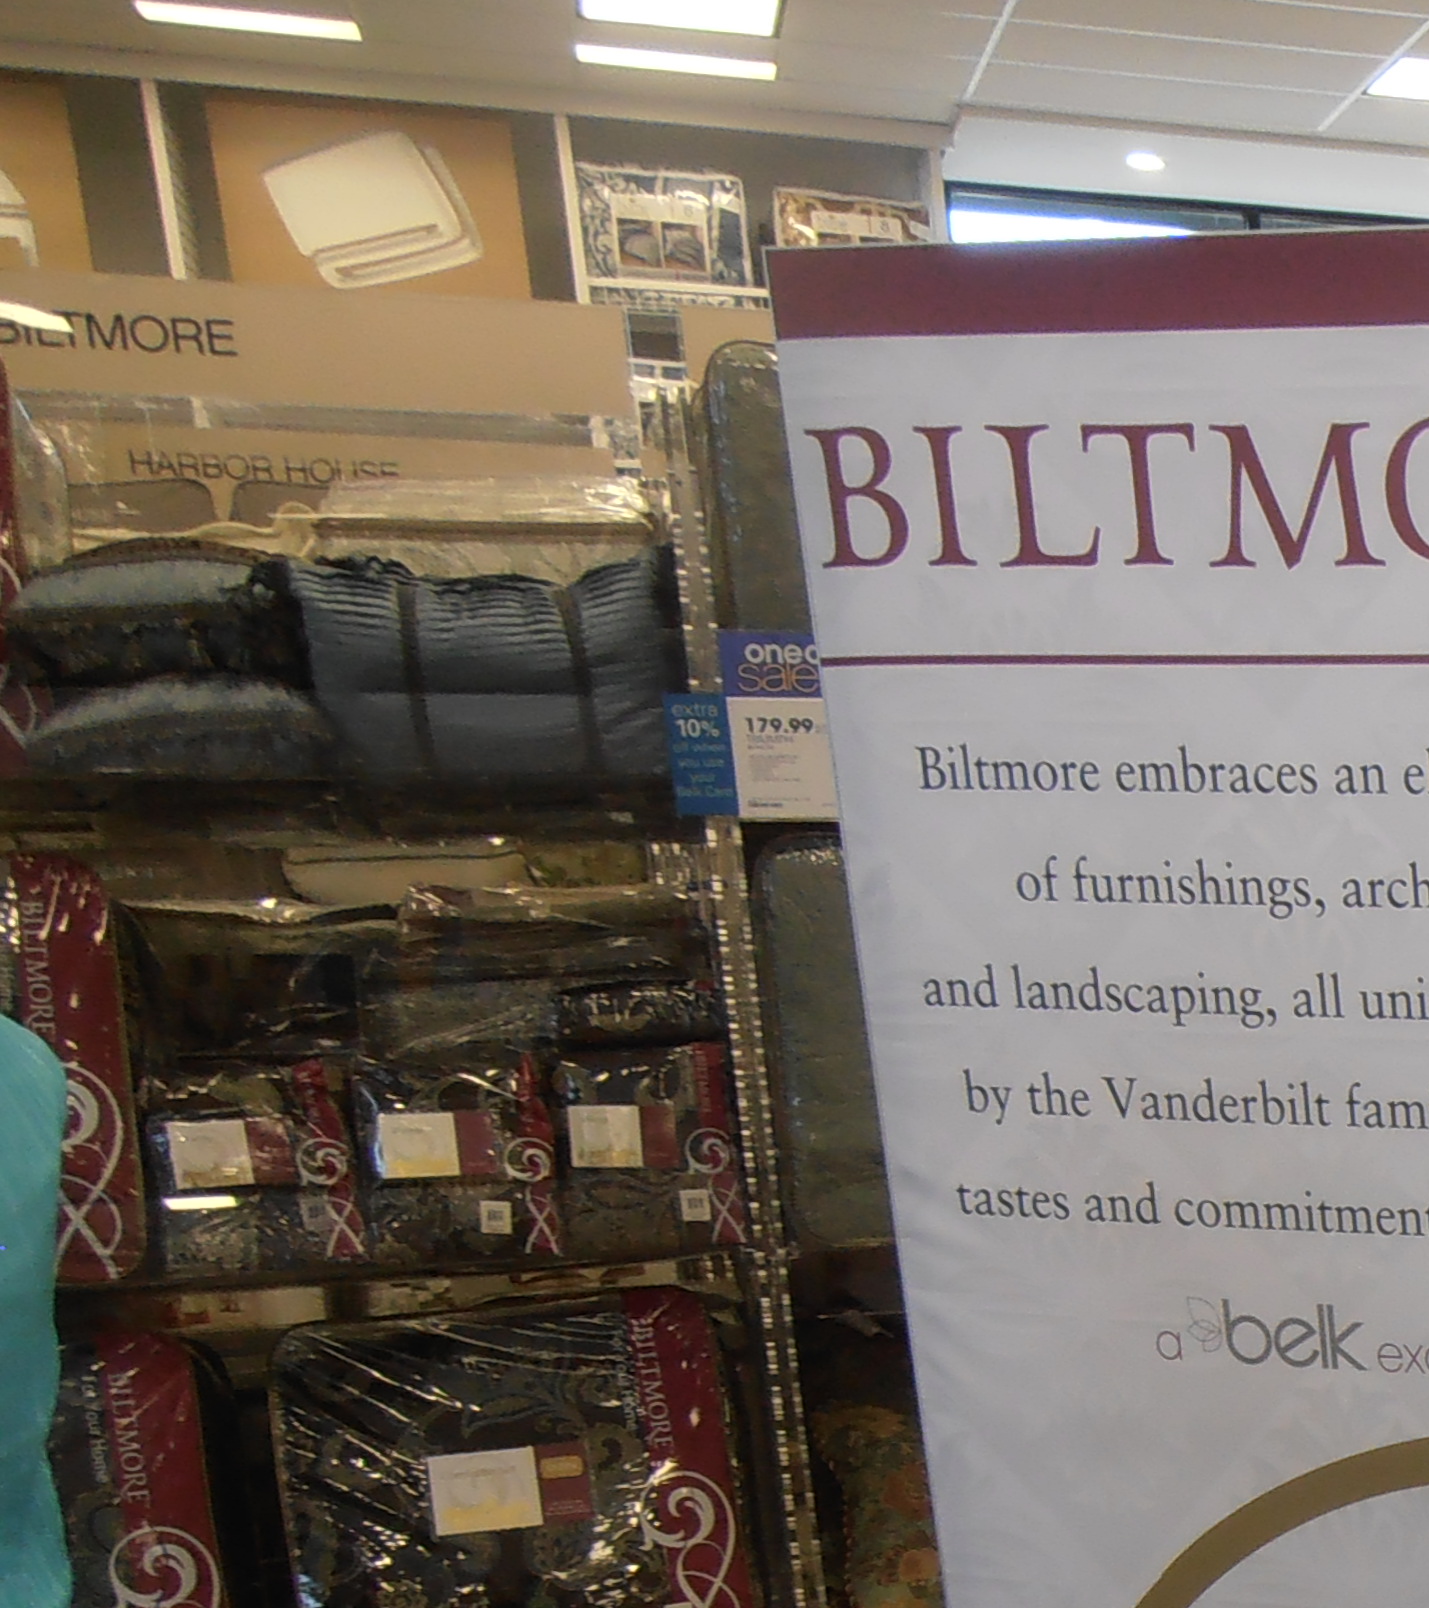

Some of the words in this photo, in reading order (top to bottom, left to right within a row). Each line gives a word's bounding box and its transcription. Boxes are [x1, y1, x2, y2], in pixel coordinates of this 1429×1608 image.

[129, 449, 274, 482] HARBOR
[737, 662, 819, 693] sale
[671, 703, 719, 717] extra
[675, 718, 720, 738] 10%
[744, 716, 815, 735] 179.99
[916, 745, 1100, 794] Biltmore
[1115, 747, 1319, 797] embraces
[1334, 760, 1387, 797] an
[1016, 856, 1060, 902] of
[1072, 858, 1327, 919] furnishings,
[923, 964, 998, 1011] and
[1011, 964, 1278, 1029] landscaping,
[1292, 972, 1345, 1021] all
[963, 1069, 1013, 1125] by
[1027, 1072, 1091, 1118] the
[1101, 1076, 1331, 1129] Vanderbilt
[956, 1182, 1071, 1222] tastes
[1085, 1181, 1160, 1227] and
[1155, 1326, 1184, 1362] a
[1222, 1299, 1368, 1372] belk
[635, 1325, 675, 1450] BILTMORE
